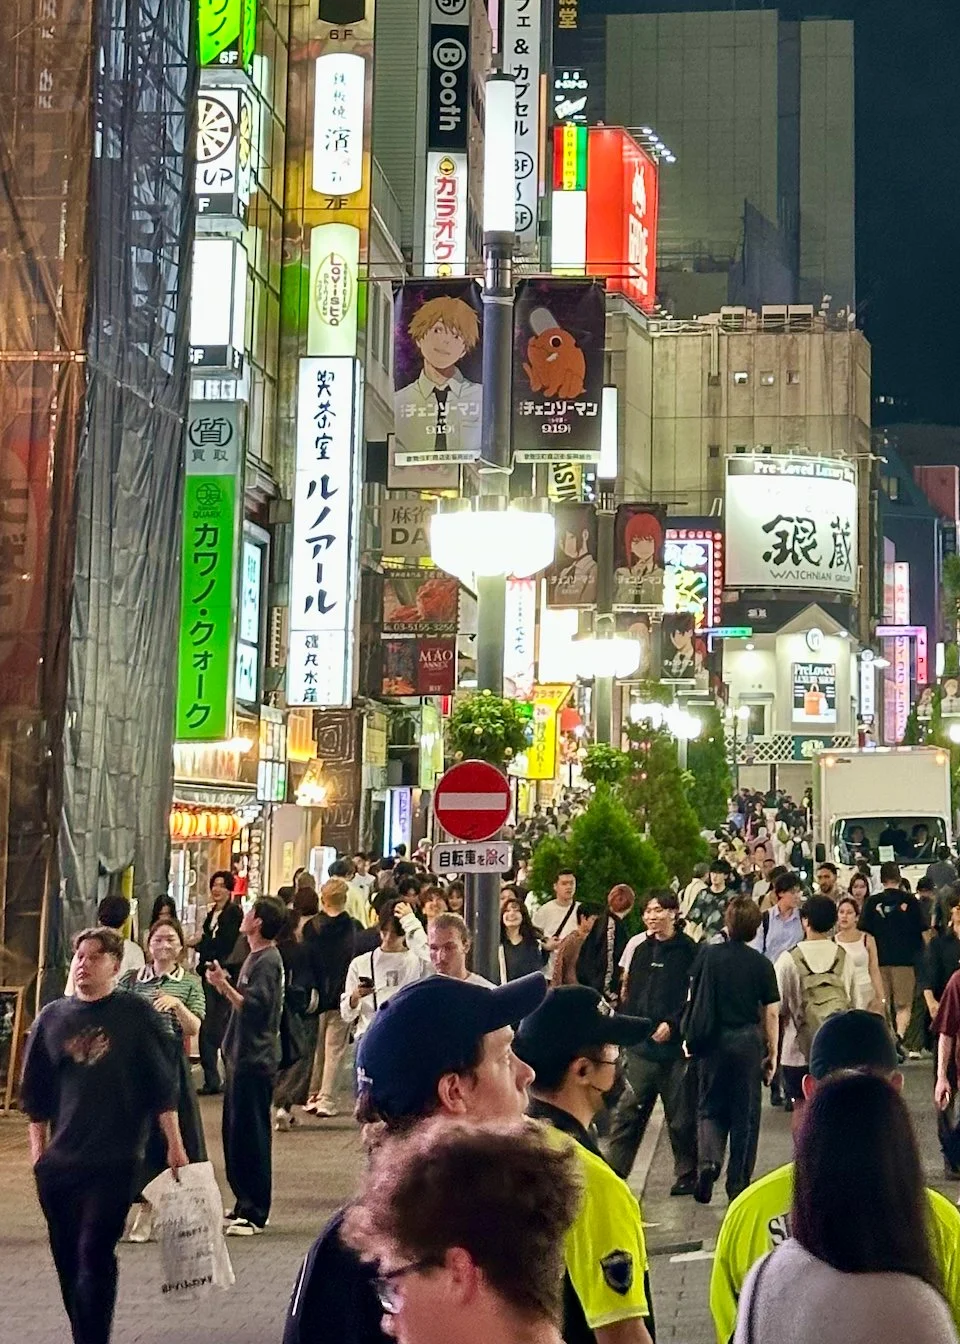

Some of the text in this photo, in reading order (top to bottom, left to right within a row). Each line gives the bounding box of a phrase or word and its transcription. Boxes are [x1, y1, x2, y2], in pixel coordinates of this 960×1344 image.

[329, 29, 353, 40] 6F
[219, 52, 238, 64] 5F
[514, 39, 530, 55] &
[433, 37, 467, 132] Booth
[513, 64, 530, 137] カプセル
[325, 199, 349, 210] 7F
[435, 175, 459, 260] カラオケ
[523, 401, 598, 417] チェンソーマン
[193, 417, 228, 446] 質
[191, 448, 229, 462] 買取
[753, 462, 814, 476] Pre-Loved
[304, 369, 339, 615] 喫茶室 ルノアール
[762, 514, 853, 572] 銀蔵
[770, 569, 832, 582] WATCHNIAN
[185, 522, 220, 731] カワノ・クォーク
[303, 634, 319, 704] 磯丸水産
